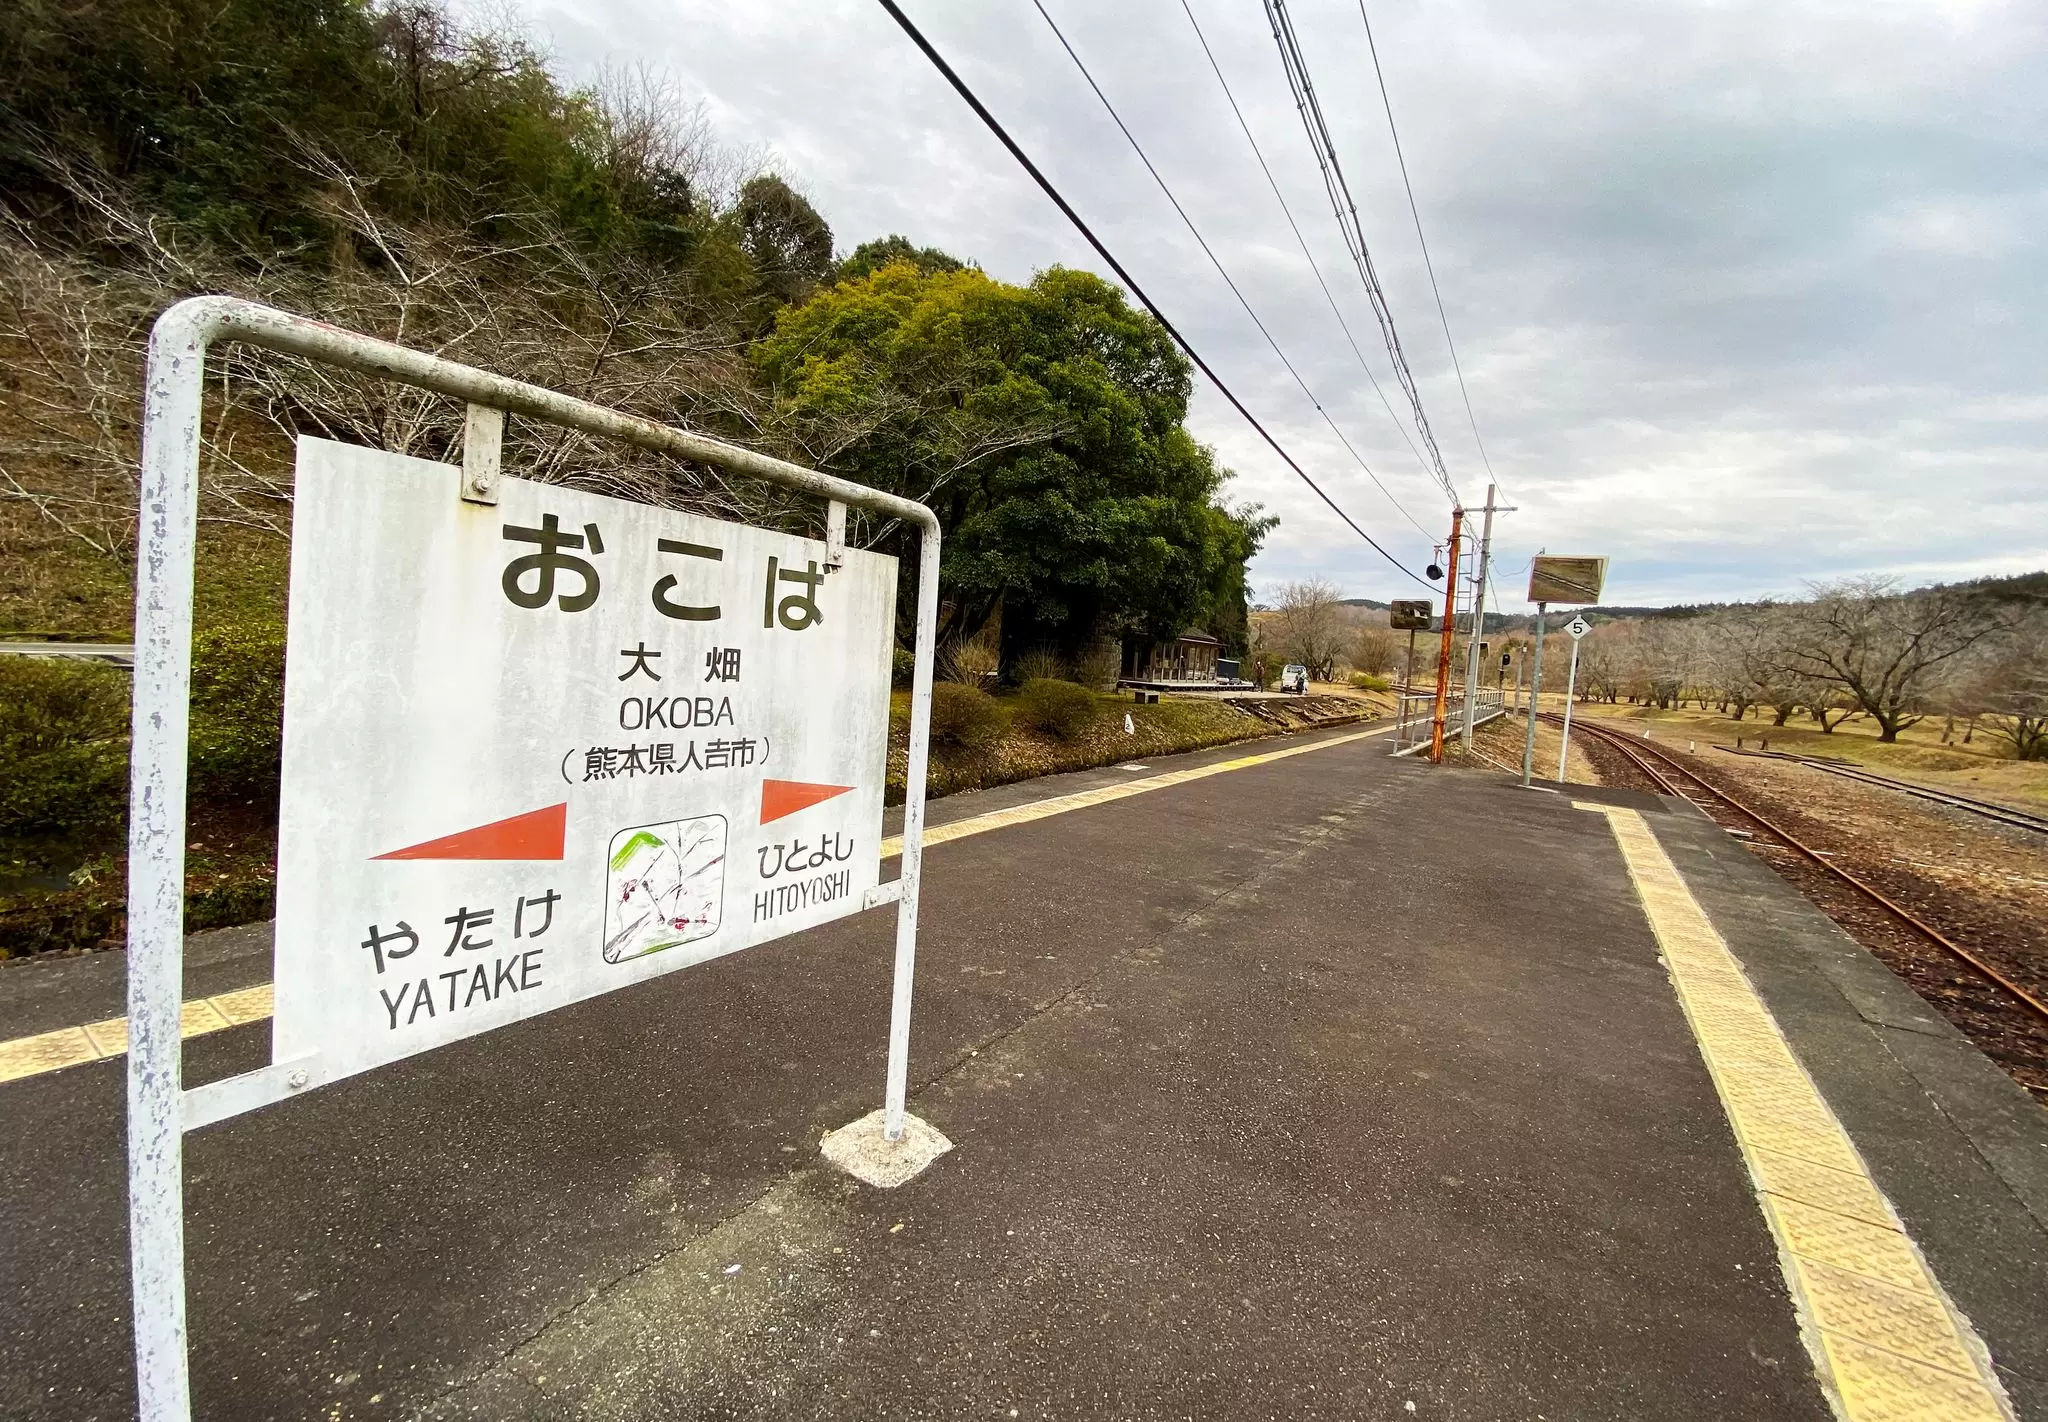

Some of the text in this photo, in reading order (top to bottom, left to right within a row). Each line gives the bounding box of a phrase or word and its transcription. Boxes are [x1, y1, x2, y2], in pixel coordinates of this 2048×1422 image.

[502, 513, 839, 631] おこば
[1573, 622, 1583, 634] 5
[618, 642, 741, 682] 大畑
[619, 696, 734, 730] OKOBA
[757, 831, 854, 879] ひとよし
[753, 869, 850, 923] HITOYOSHI
[361, 888, 562, 975] やたけ
[379, 949, 544, 1030] YATAKE
